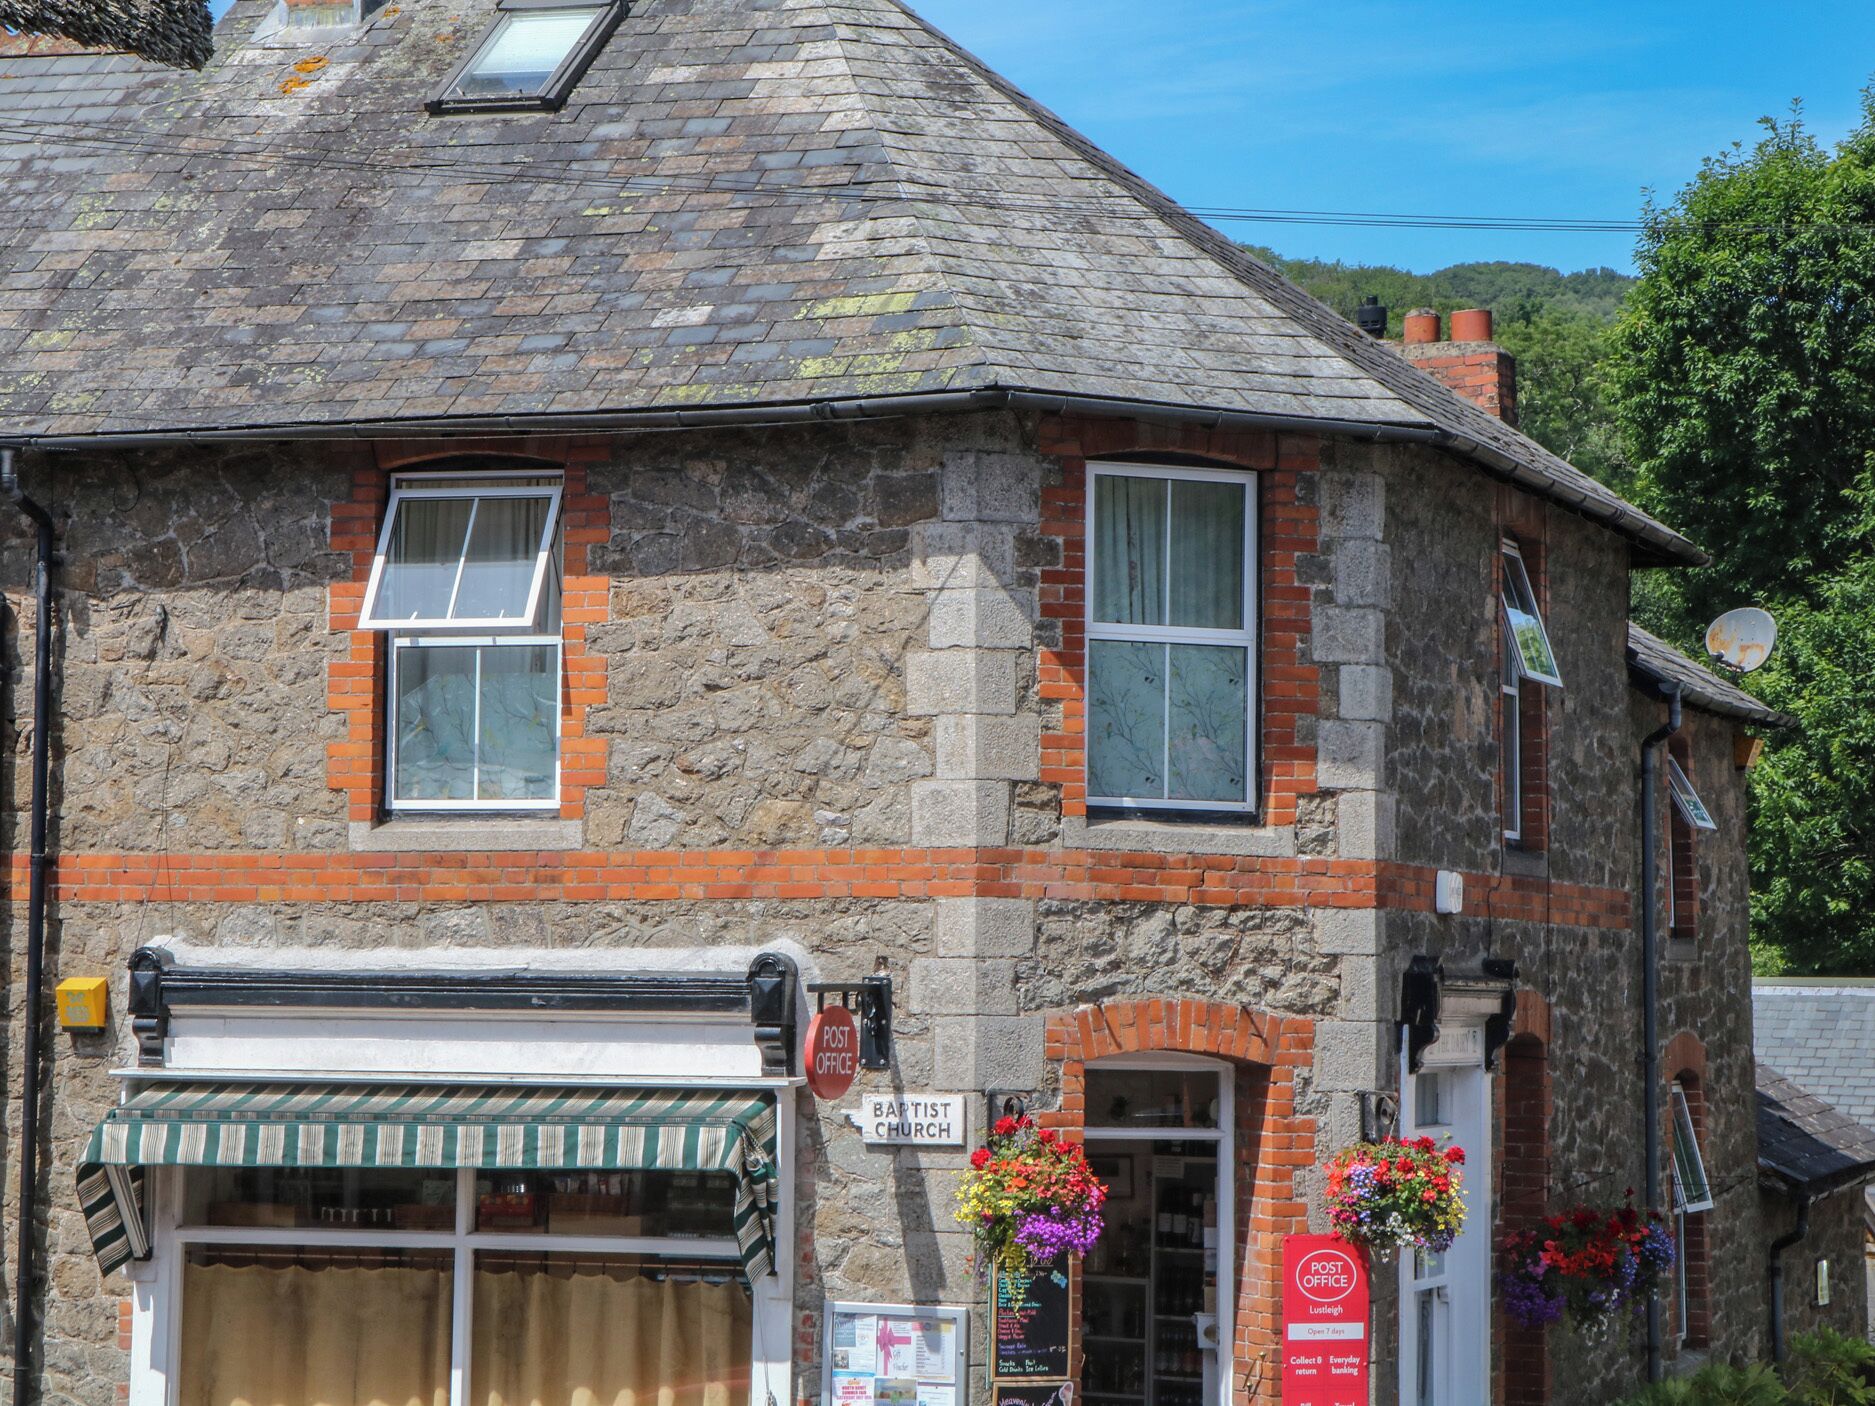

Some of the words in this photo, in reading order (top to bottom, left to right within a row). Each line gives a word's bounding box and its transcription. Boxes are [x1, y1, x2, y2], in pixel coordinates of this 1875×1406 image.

[823, 1026, 850, 1048] POST
[816, 1052, 852, 1075] OFFICE
[873, 1101, 951, 1119] BAPTIST
[875, 1121, 951, 1139] CHURCH
[1311, 1261, 1343, 1274] POST
[1303, 1275, 1348, 1288] OFFICE
[1309, 1305, 1343, 1315] Lustleigh
[1307, 1328, 1325, 1336] Open
[1331, 1328, 1345, 1336] days
[1290, 1356, 1316, 1364] Collect
[1329, 1355, 1360, 1365] Everyday
[1331, 1366, 1359, 1376] banking
